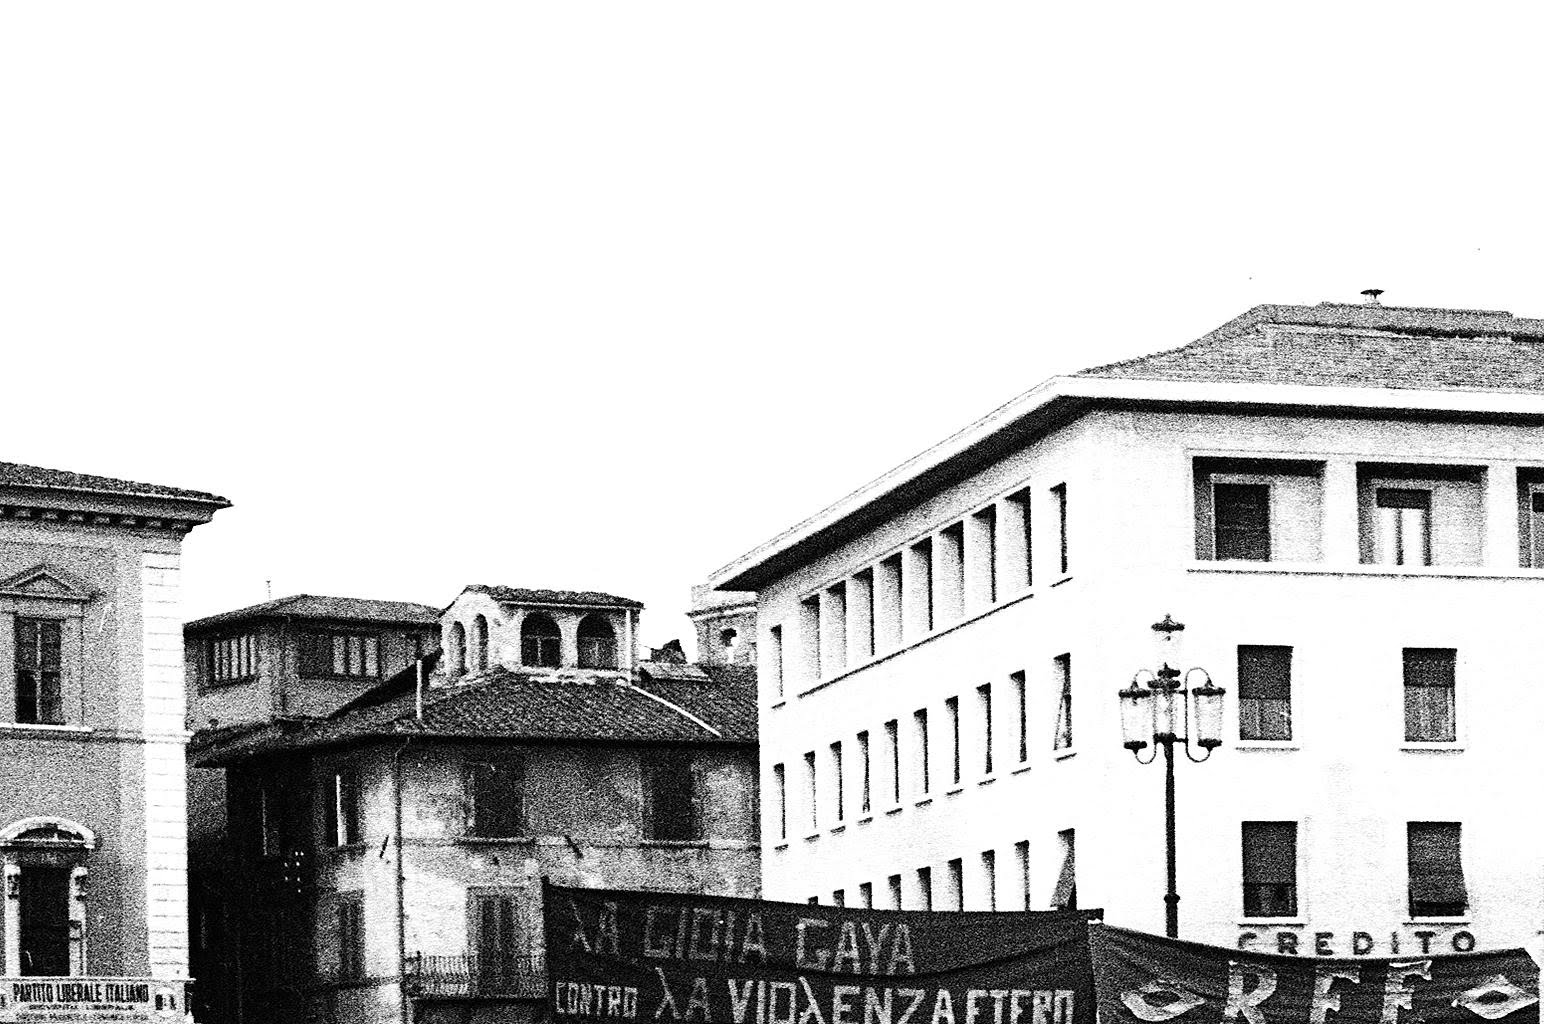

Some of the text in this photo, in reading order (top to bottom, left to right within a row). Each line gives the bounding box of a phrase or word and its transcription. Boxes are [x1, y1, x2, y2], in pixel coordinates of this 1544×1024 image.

[796, 916, 915, 975] GAYA
[1237, 931, 1476, 956] CREDITO
[13, 984, 149, 1003] PARTITO LIBERALE ITALIANO
[555, 980, 639, 1018] CONTRO
